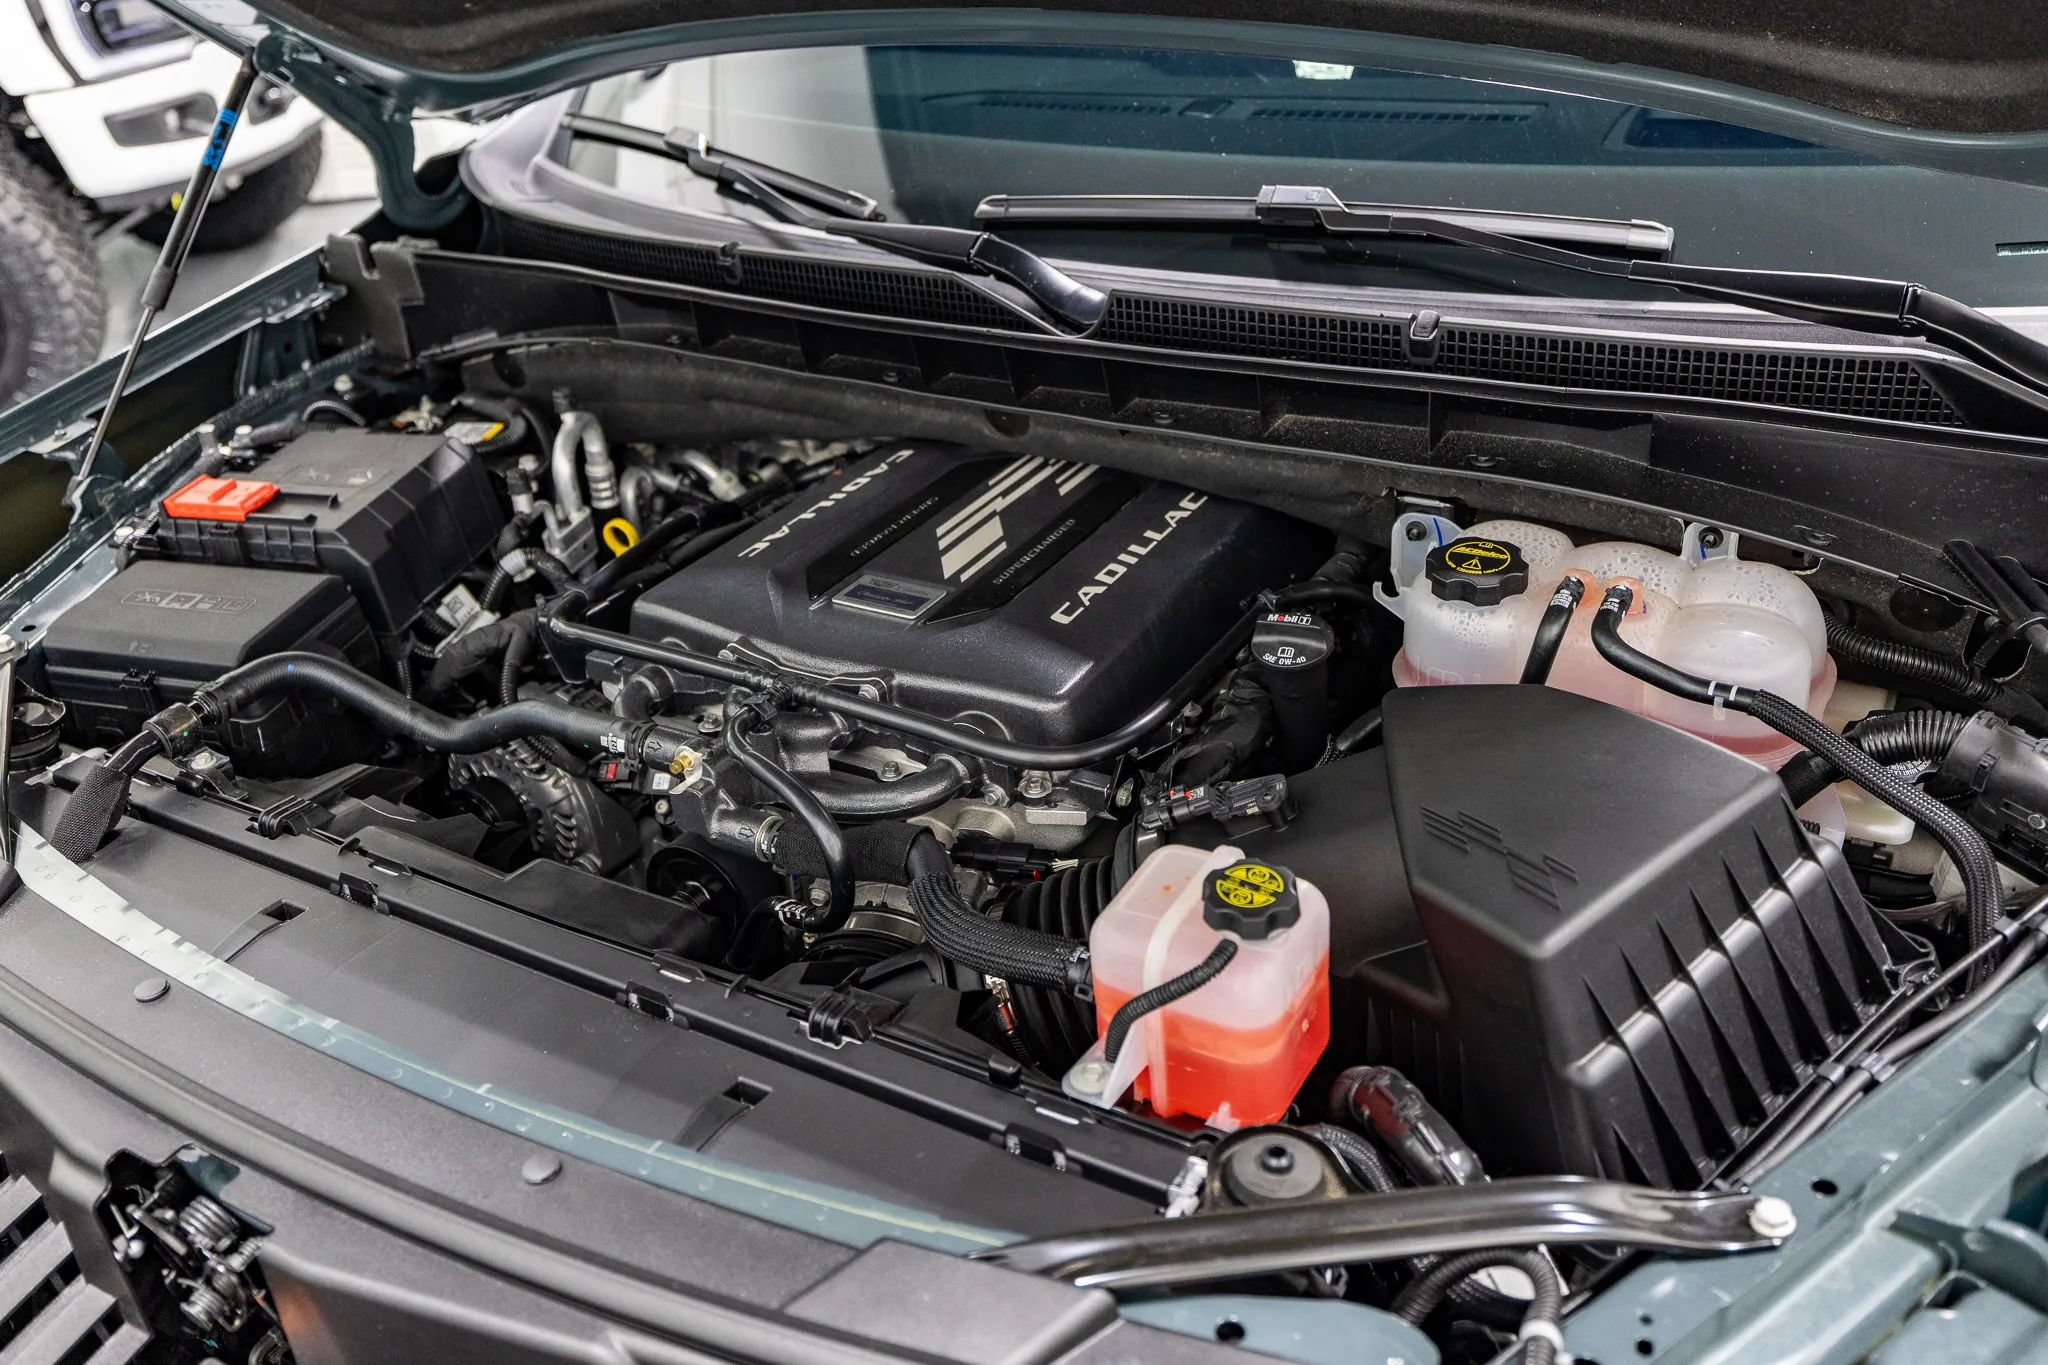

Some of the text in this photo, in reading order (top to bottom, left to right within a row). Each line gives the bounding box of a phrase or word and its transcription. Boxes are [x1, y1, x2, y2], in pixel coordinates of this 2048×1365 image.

[738, 449, 914, 557] CADILLAC
[993, 518, 1076, 585] SUPERCHARGED
[1050, 491, 1208, 624] CADILLAC
[1452, 547, 1508, 559] ACDelco
[1267, 614, 1298, 623] Mobil
[1262, 653, 1307, 665] SAE 0W-40
